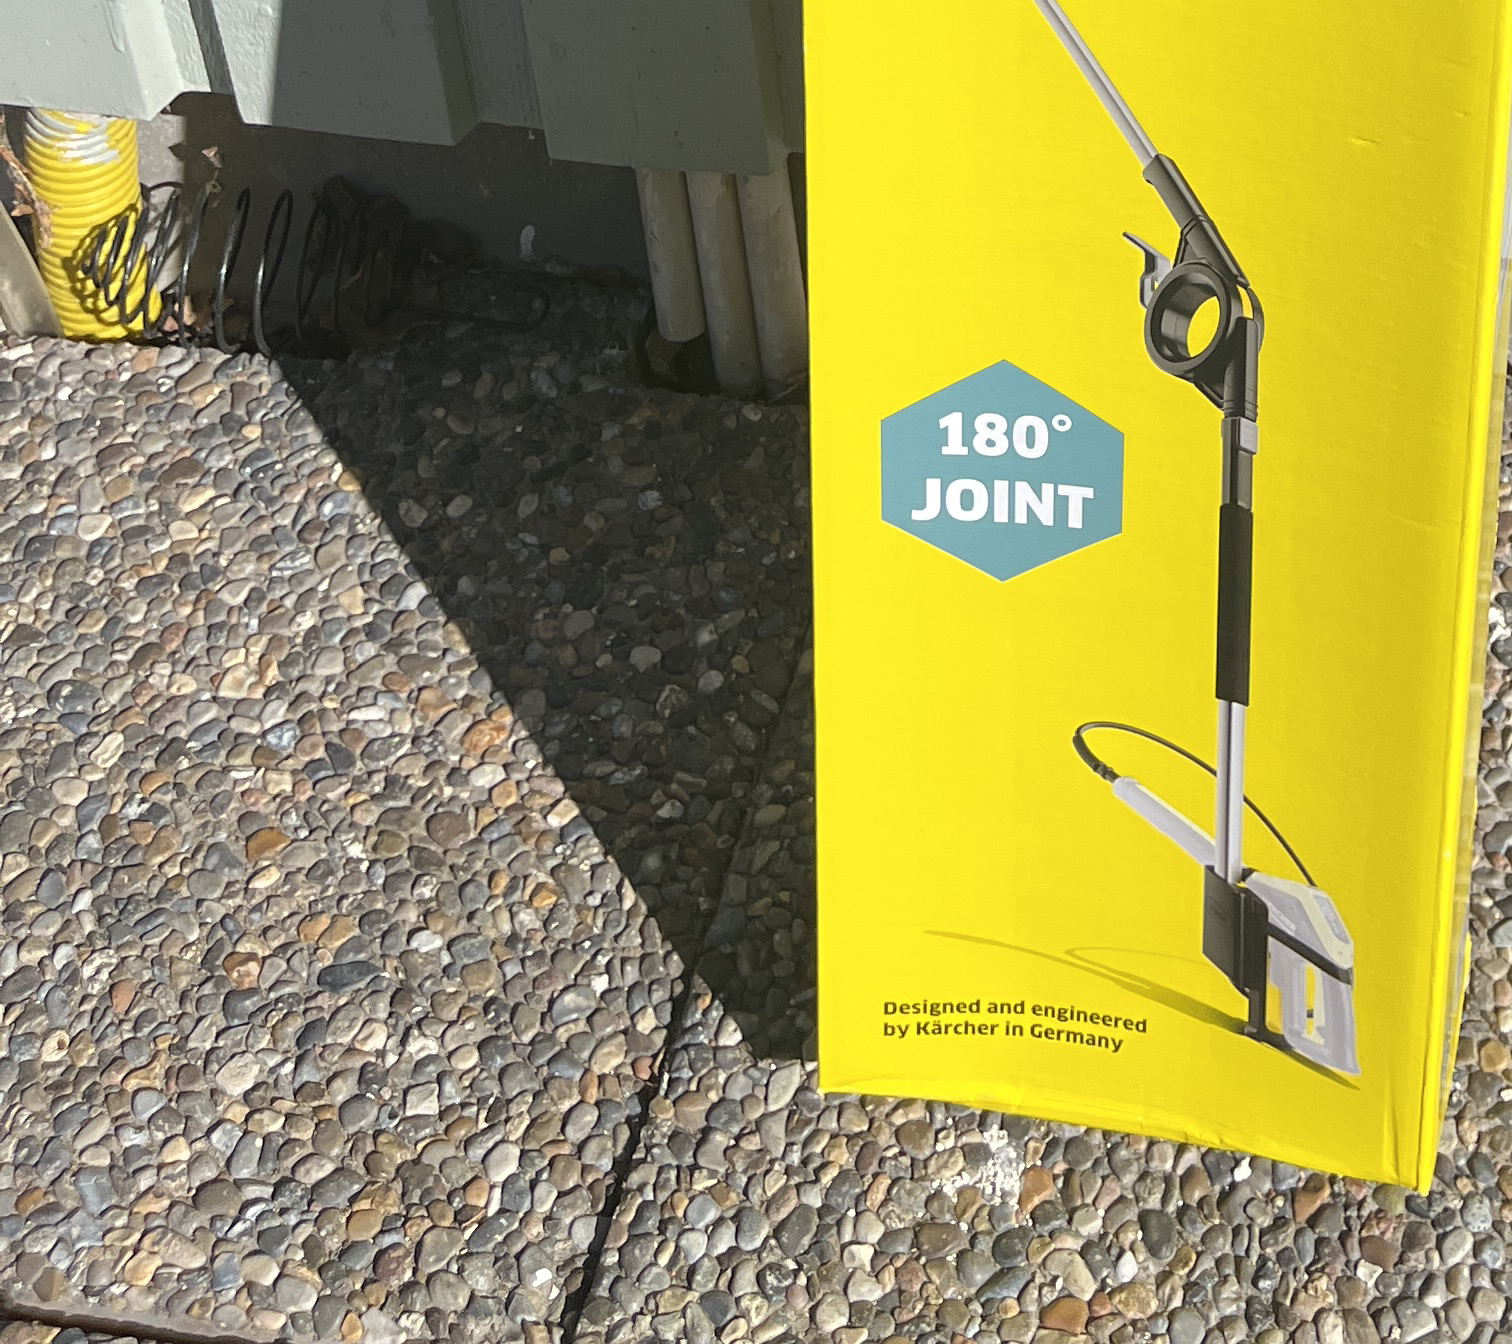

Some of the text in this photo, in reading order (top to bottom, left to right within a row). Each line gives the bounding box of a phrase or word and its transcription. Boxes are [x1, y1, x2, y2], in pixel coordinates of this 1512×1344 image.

[938, 411, 1073, 459] 180°
[911, 477, 1095, 529] JOINT
[883, 999, 1148, 1033] Designed and engineered
[883, 1020, 1124, 1053] by Kärcher in Germany
